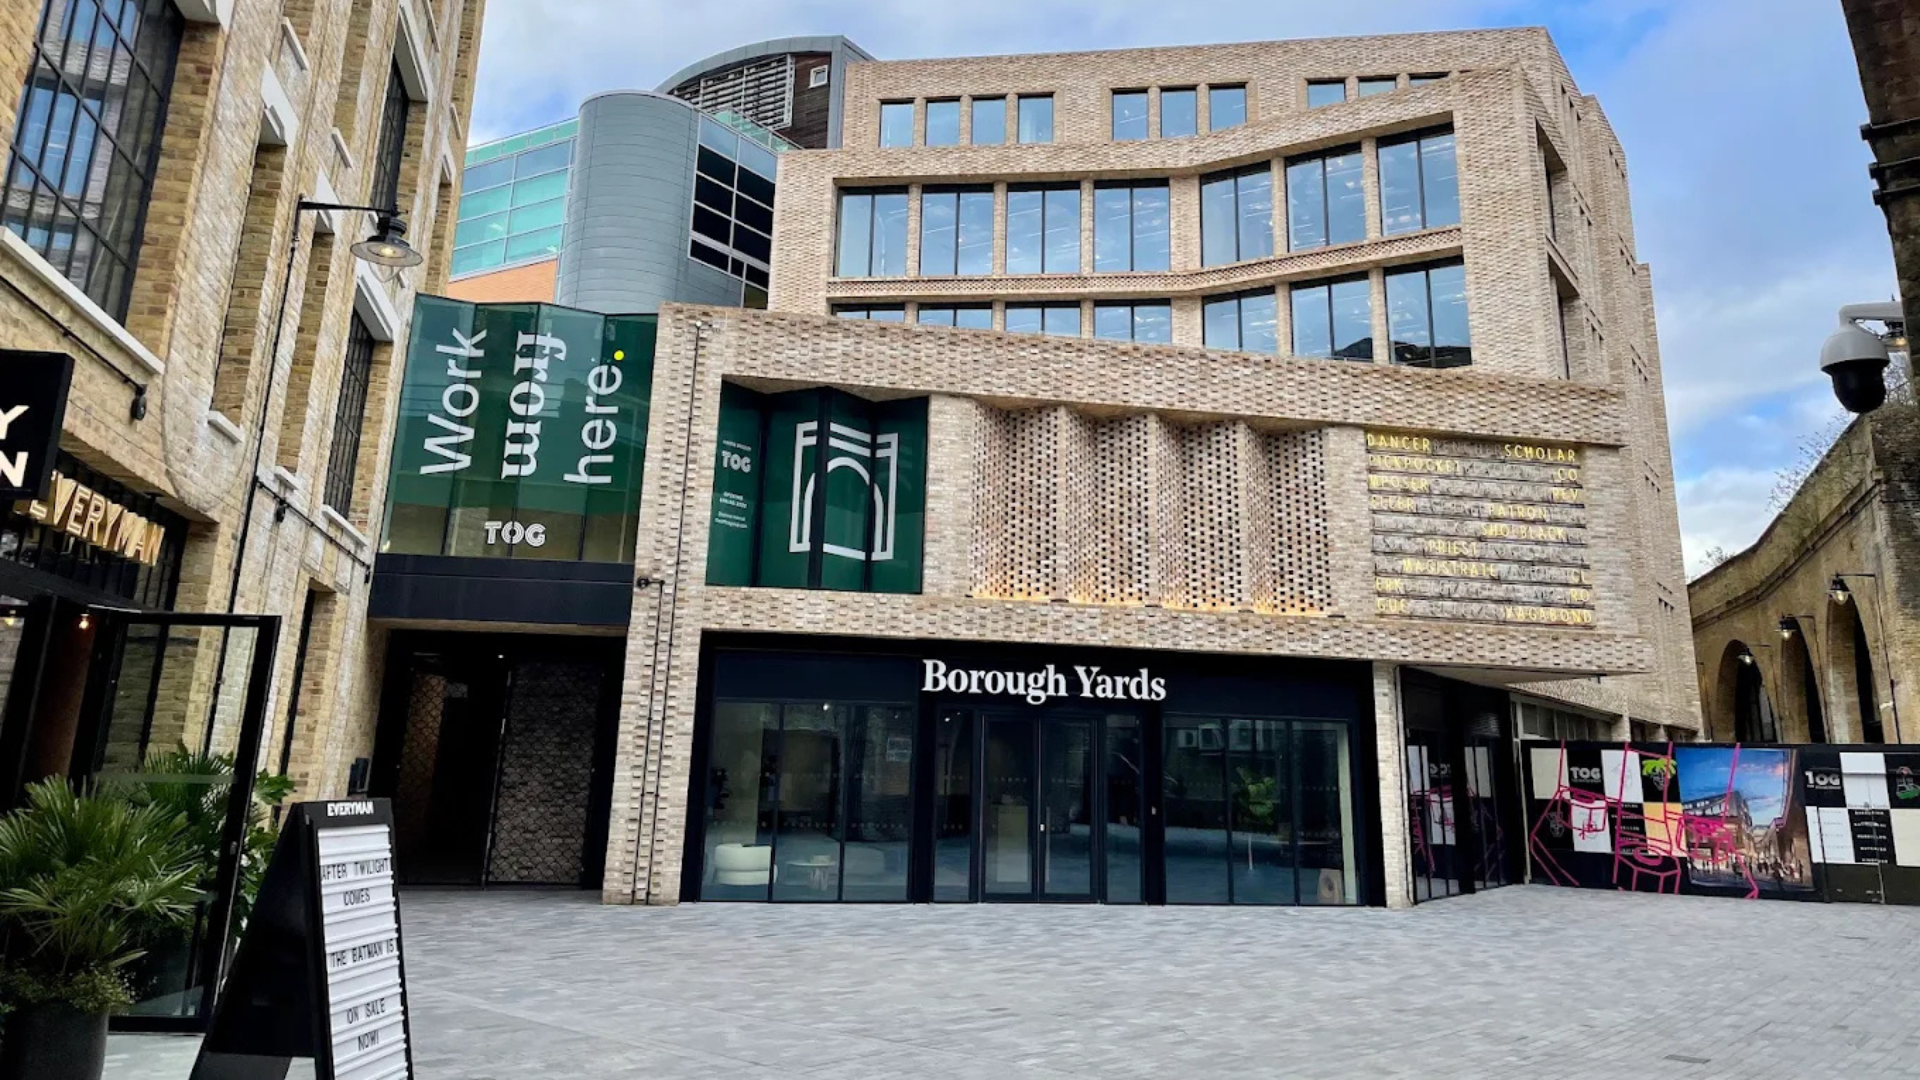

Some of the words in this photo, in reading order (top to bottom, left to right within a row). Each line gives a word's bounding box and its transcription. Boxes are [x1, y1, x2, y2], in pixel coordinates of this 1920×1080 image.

[419, 327, 487, 475] Work
[501, 330, 567, 480] from
[1367, 433, 1430, 451] DANCER
[1504, 444, 1575, 462] SCHOLAR
[722, 450, 752, 473] TOG
[1369, 455, 1460, 472] PICKPOCKET
[1558, 468, 1577, 480] CO
[1488, 503, 1547, 519] PATRON
[484, 520, 546, 547] TOG
[1428, 539, 1477, 555] PRIEST
[1403, 559, 1496, 577] MAGISTRATE
[1504, 605, 1592, 623] VAGABOND
[921, 658, 1069, 705] Borough
[1073, 665, 1167, 701] Yards
[1569, 766, 1602, 779] TOG
[327, 801, 374, 817] EVERYMAN
[321, 862, 348, 881] AFTER
[354, 857, 389, 877] TWILIGHT
[343, 888, 371, 906] COMES
[331, 951, 347, 968] THE
[352, 943, 384, 963] BATMAN
[386, 938, 395, 954] IS
[347, 1007, 359, 1025] ON
[366, 998, 385, 1017] SALE
[357, 1033, 380, 1051] NOW!
